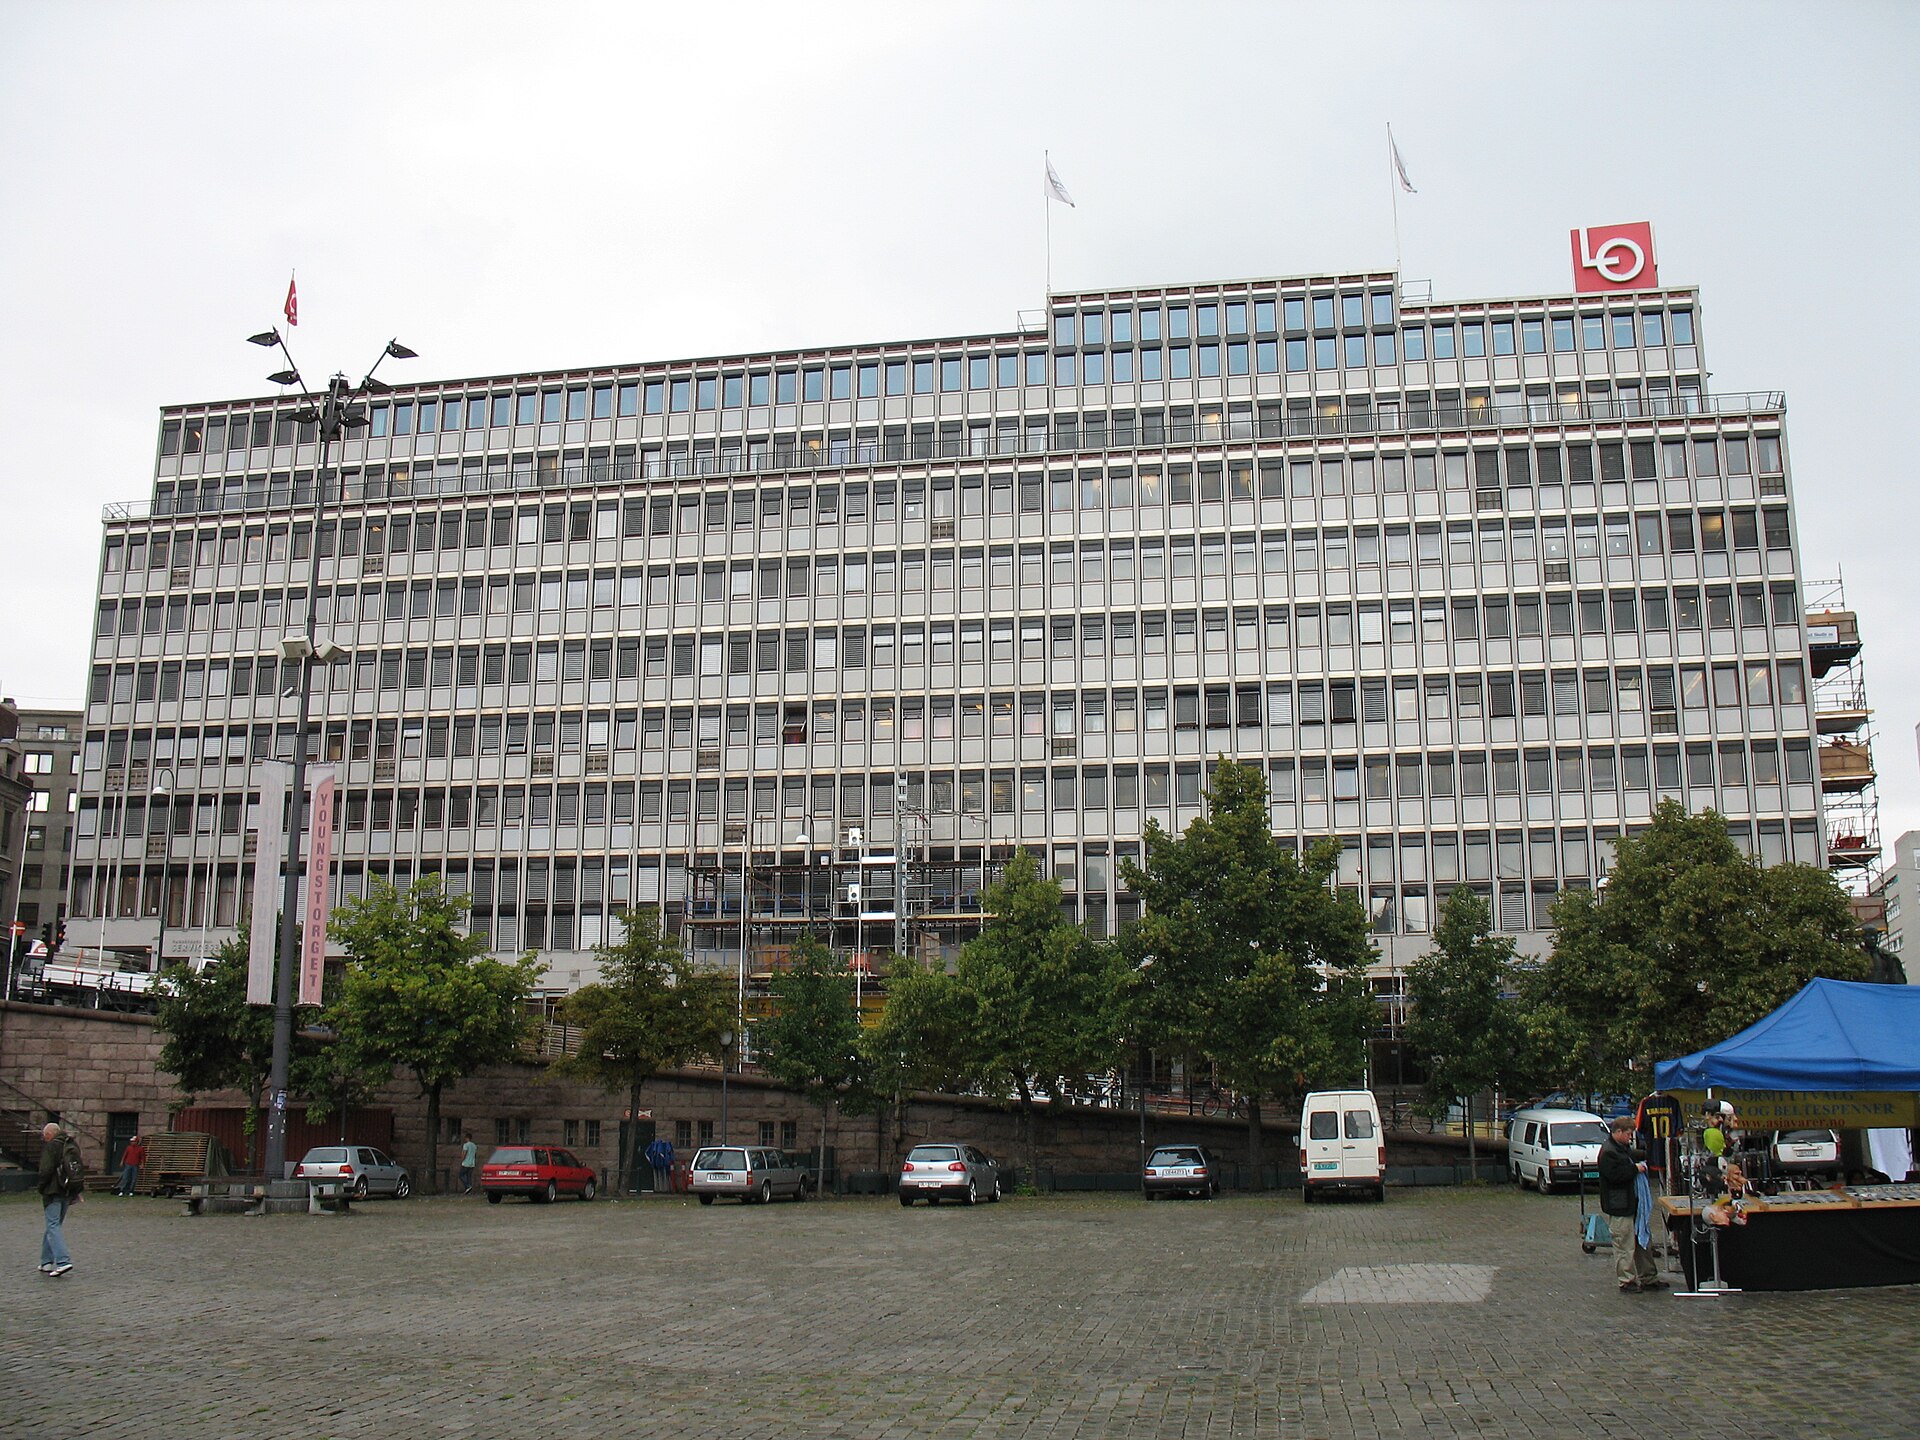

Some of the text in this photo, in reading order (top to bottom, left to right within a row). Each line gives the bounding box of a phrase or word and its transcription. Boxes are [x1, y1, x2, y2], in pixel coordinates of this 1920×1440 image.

[1579, 227, 1645, 282] LO
[309, 793, 329, 987] YOUNGSTORGET
[1652, 1116, 1670, 1138] 10
[1749, 1105, 1769, 1116] OG
[1775, 1103, 1894, 1116] BELTESPENNER
